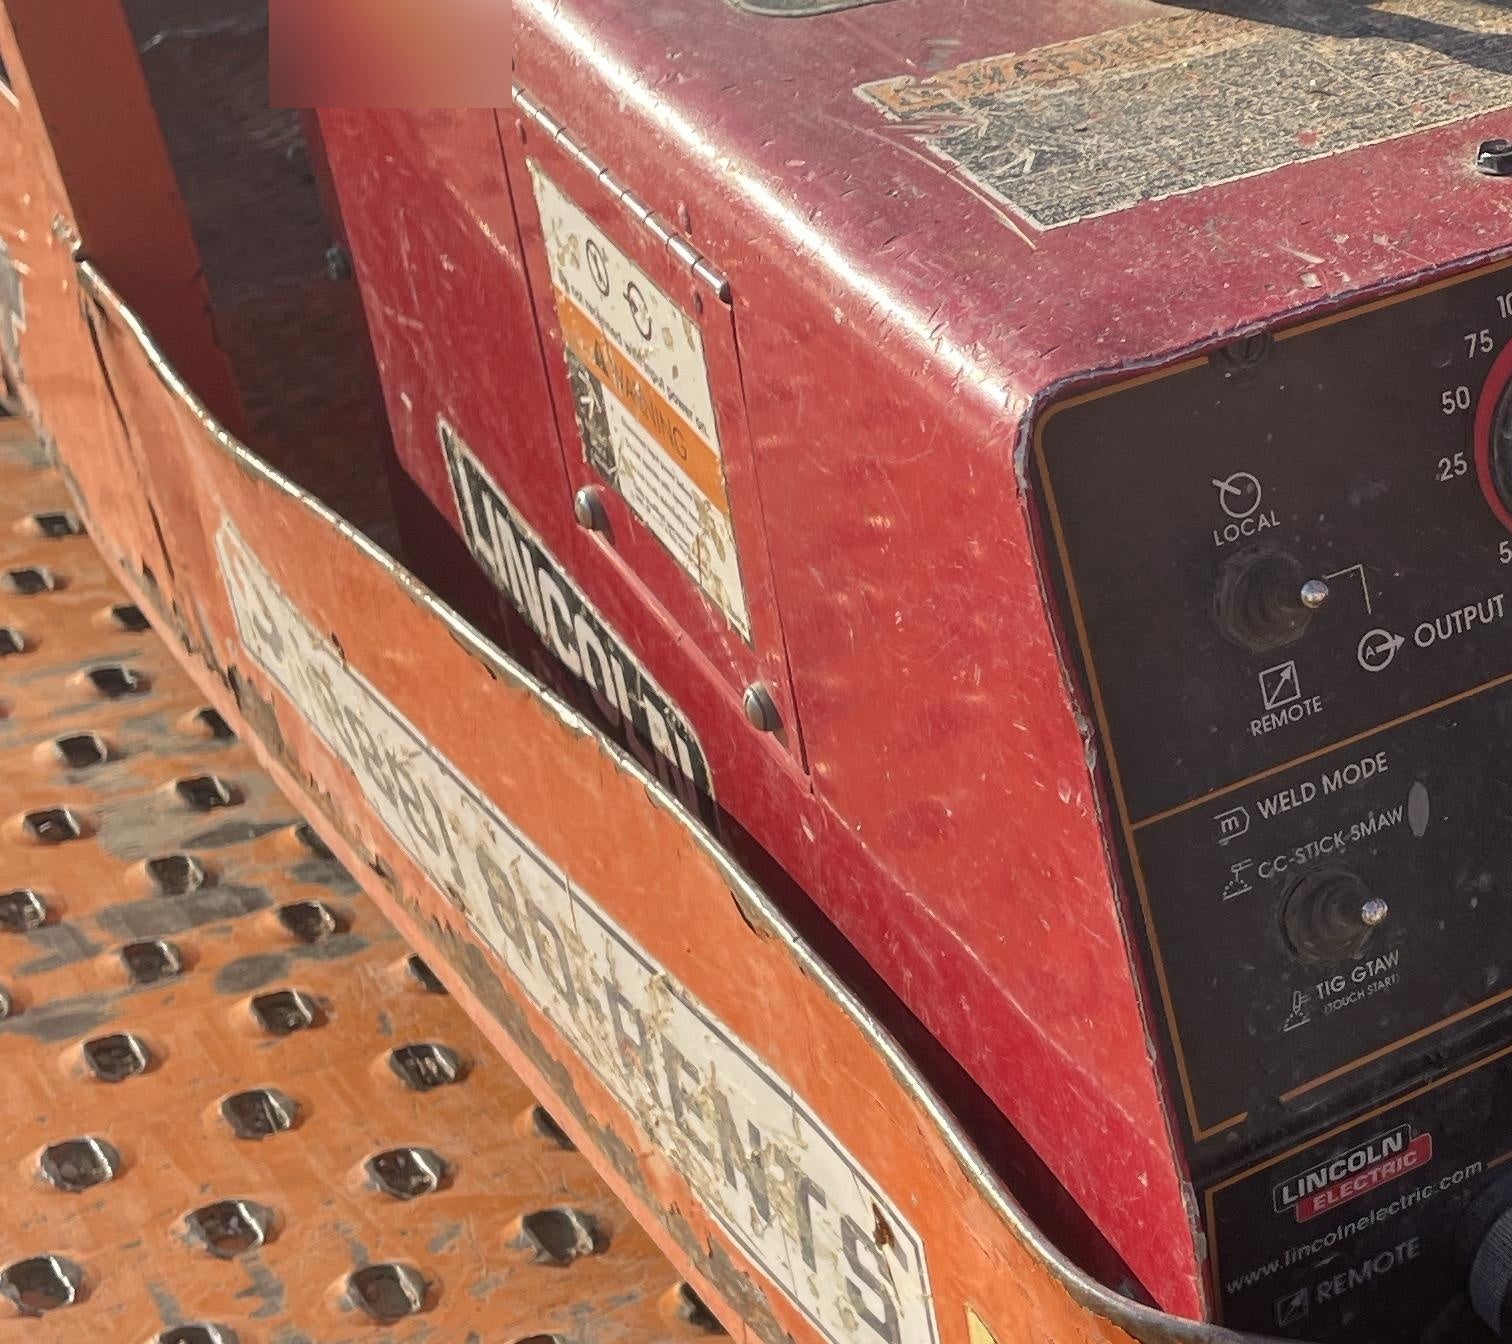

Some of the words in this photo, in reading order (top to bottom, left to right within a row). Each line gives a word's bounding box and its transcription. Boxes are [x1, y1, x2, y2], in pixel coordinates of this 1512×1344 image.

[1464, 328, 1494, 358] 75
[1441, 385, 1471, 416] 50
[1437, 452, 1467, 482] 25
[1213, 510, 1281, 546] LOCAL
[1498, 540, 1512, 564] 5
[1413, 592, 1506, 649] OUTPUT
[1250, 695, 1324, 737] REMOTE
[1256, 781, 1317, 820] WELD
[1321, 751, 1389, 795] MODE
[1315, 975, 1346, 1000] TIG
[1351, 950, 1400, 984] GTAW
[1281, 1131, 1405, 1206] LINCOLN
[1312, 1150, 1419, 1212] ELECTRIC
[1226, 1160, 1483, 1295] www.lincolnelectric.com
[1315, 1234, 1422, 1304] REMOTE
